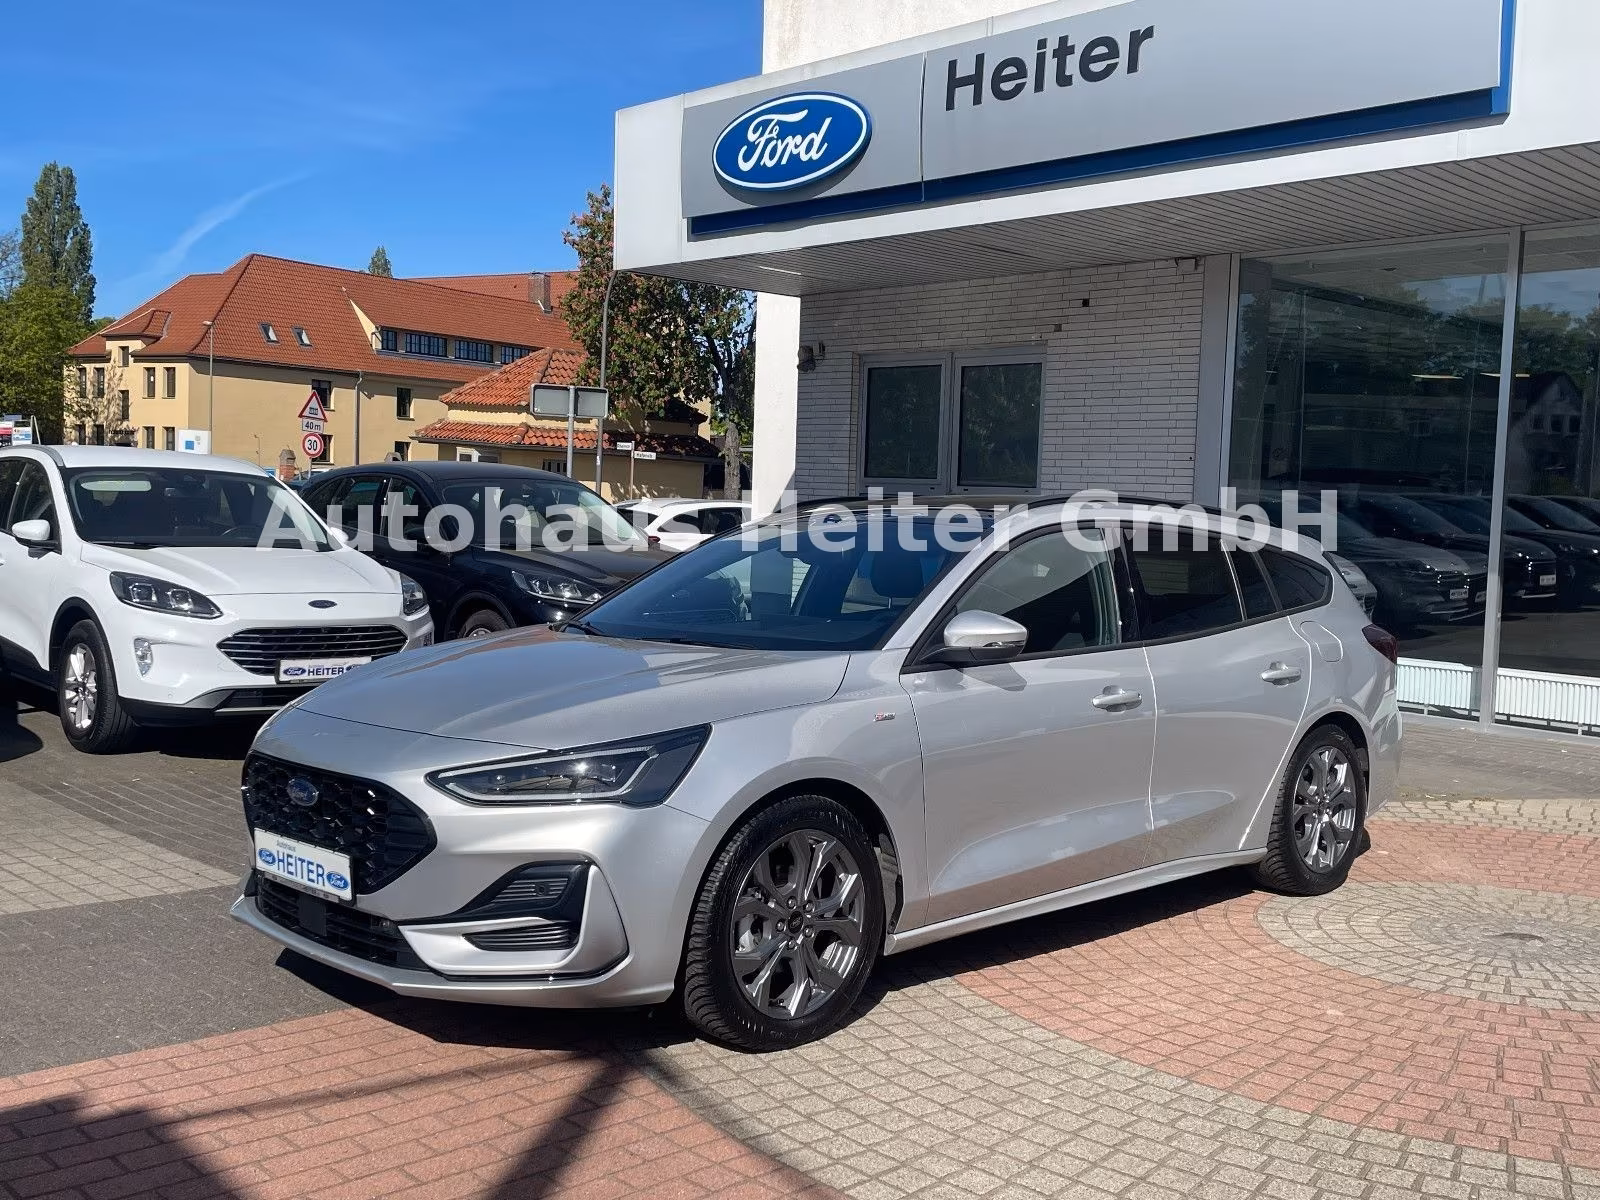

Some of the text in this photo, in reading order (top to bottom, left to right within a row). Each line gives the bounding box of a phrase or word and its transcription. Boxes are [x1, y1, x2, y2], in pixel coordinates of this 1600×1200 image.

[945, 25, 1154, 112] Heiter
[736, 109, 833, 172] Ford
[304, 421, 314, 430] 40
[307, 439, 318, 451] 30
[308, 667, 344, 676] HEITER
[276, 850, 325, 887] HEITER
[329, 873, 346, 888] Ford
